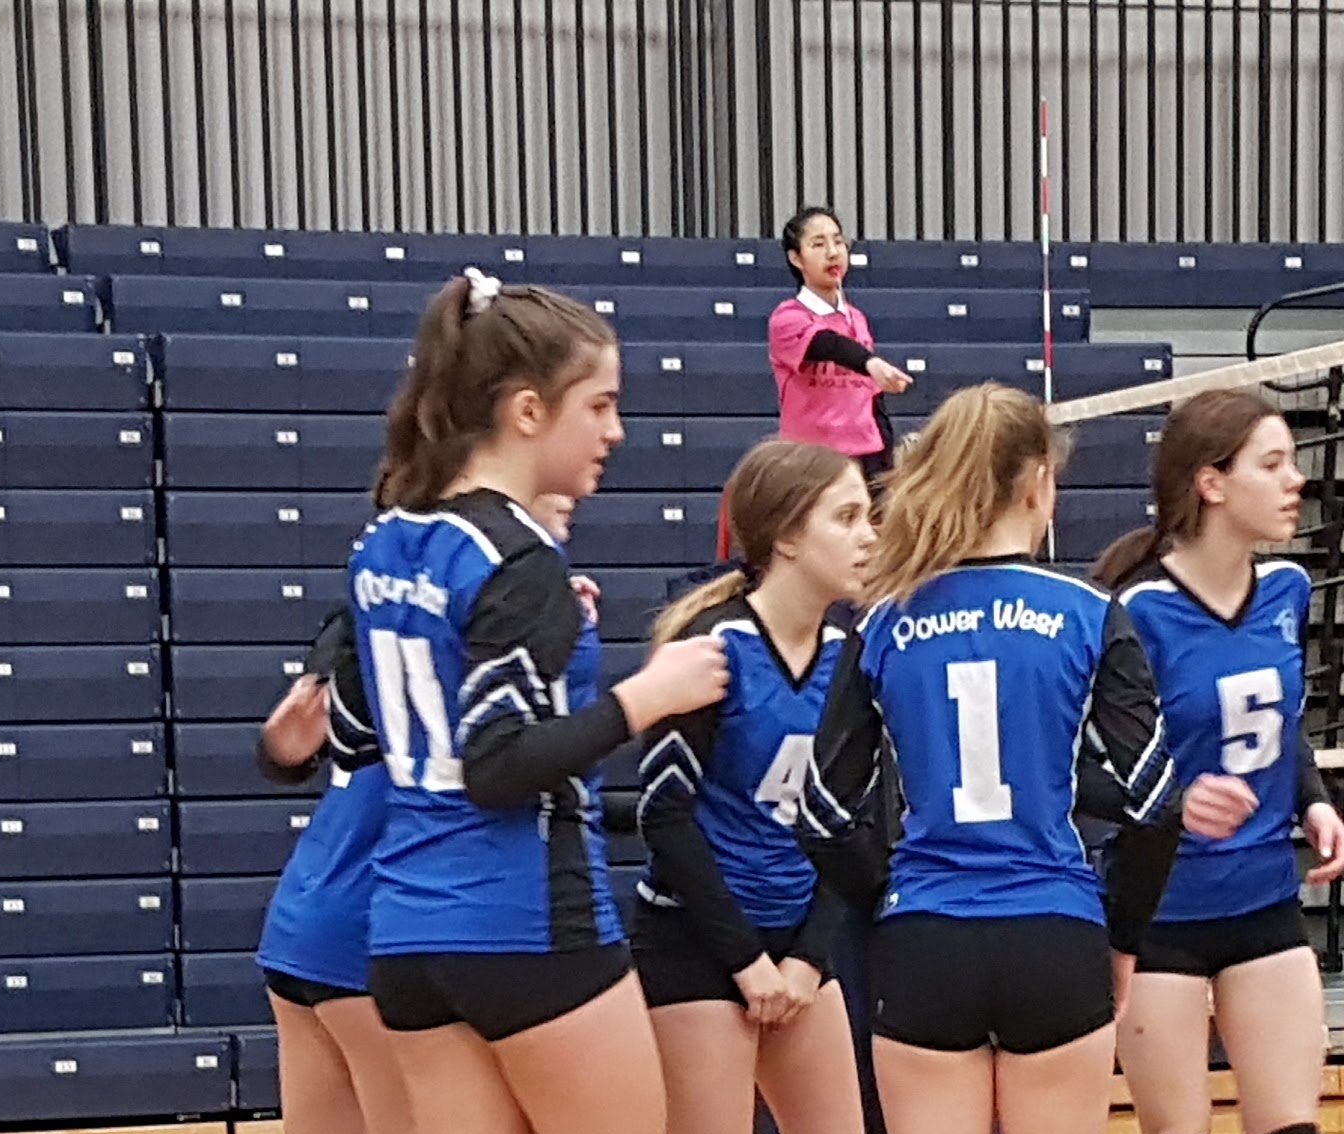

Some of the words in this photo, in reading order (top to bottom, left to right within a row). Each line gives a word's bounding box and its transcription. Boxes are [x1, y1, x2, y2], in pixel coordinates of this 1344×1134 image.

[891, 615, 985, 651] Power
[993, 598, 1064, 639] West
[369, 629, 467, 792] 11
[946, 660, 1013, 823] 1
[1216, 666, 1284, 775] 5
[754, 733, 815, 826] 4
